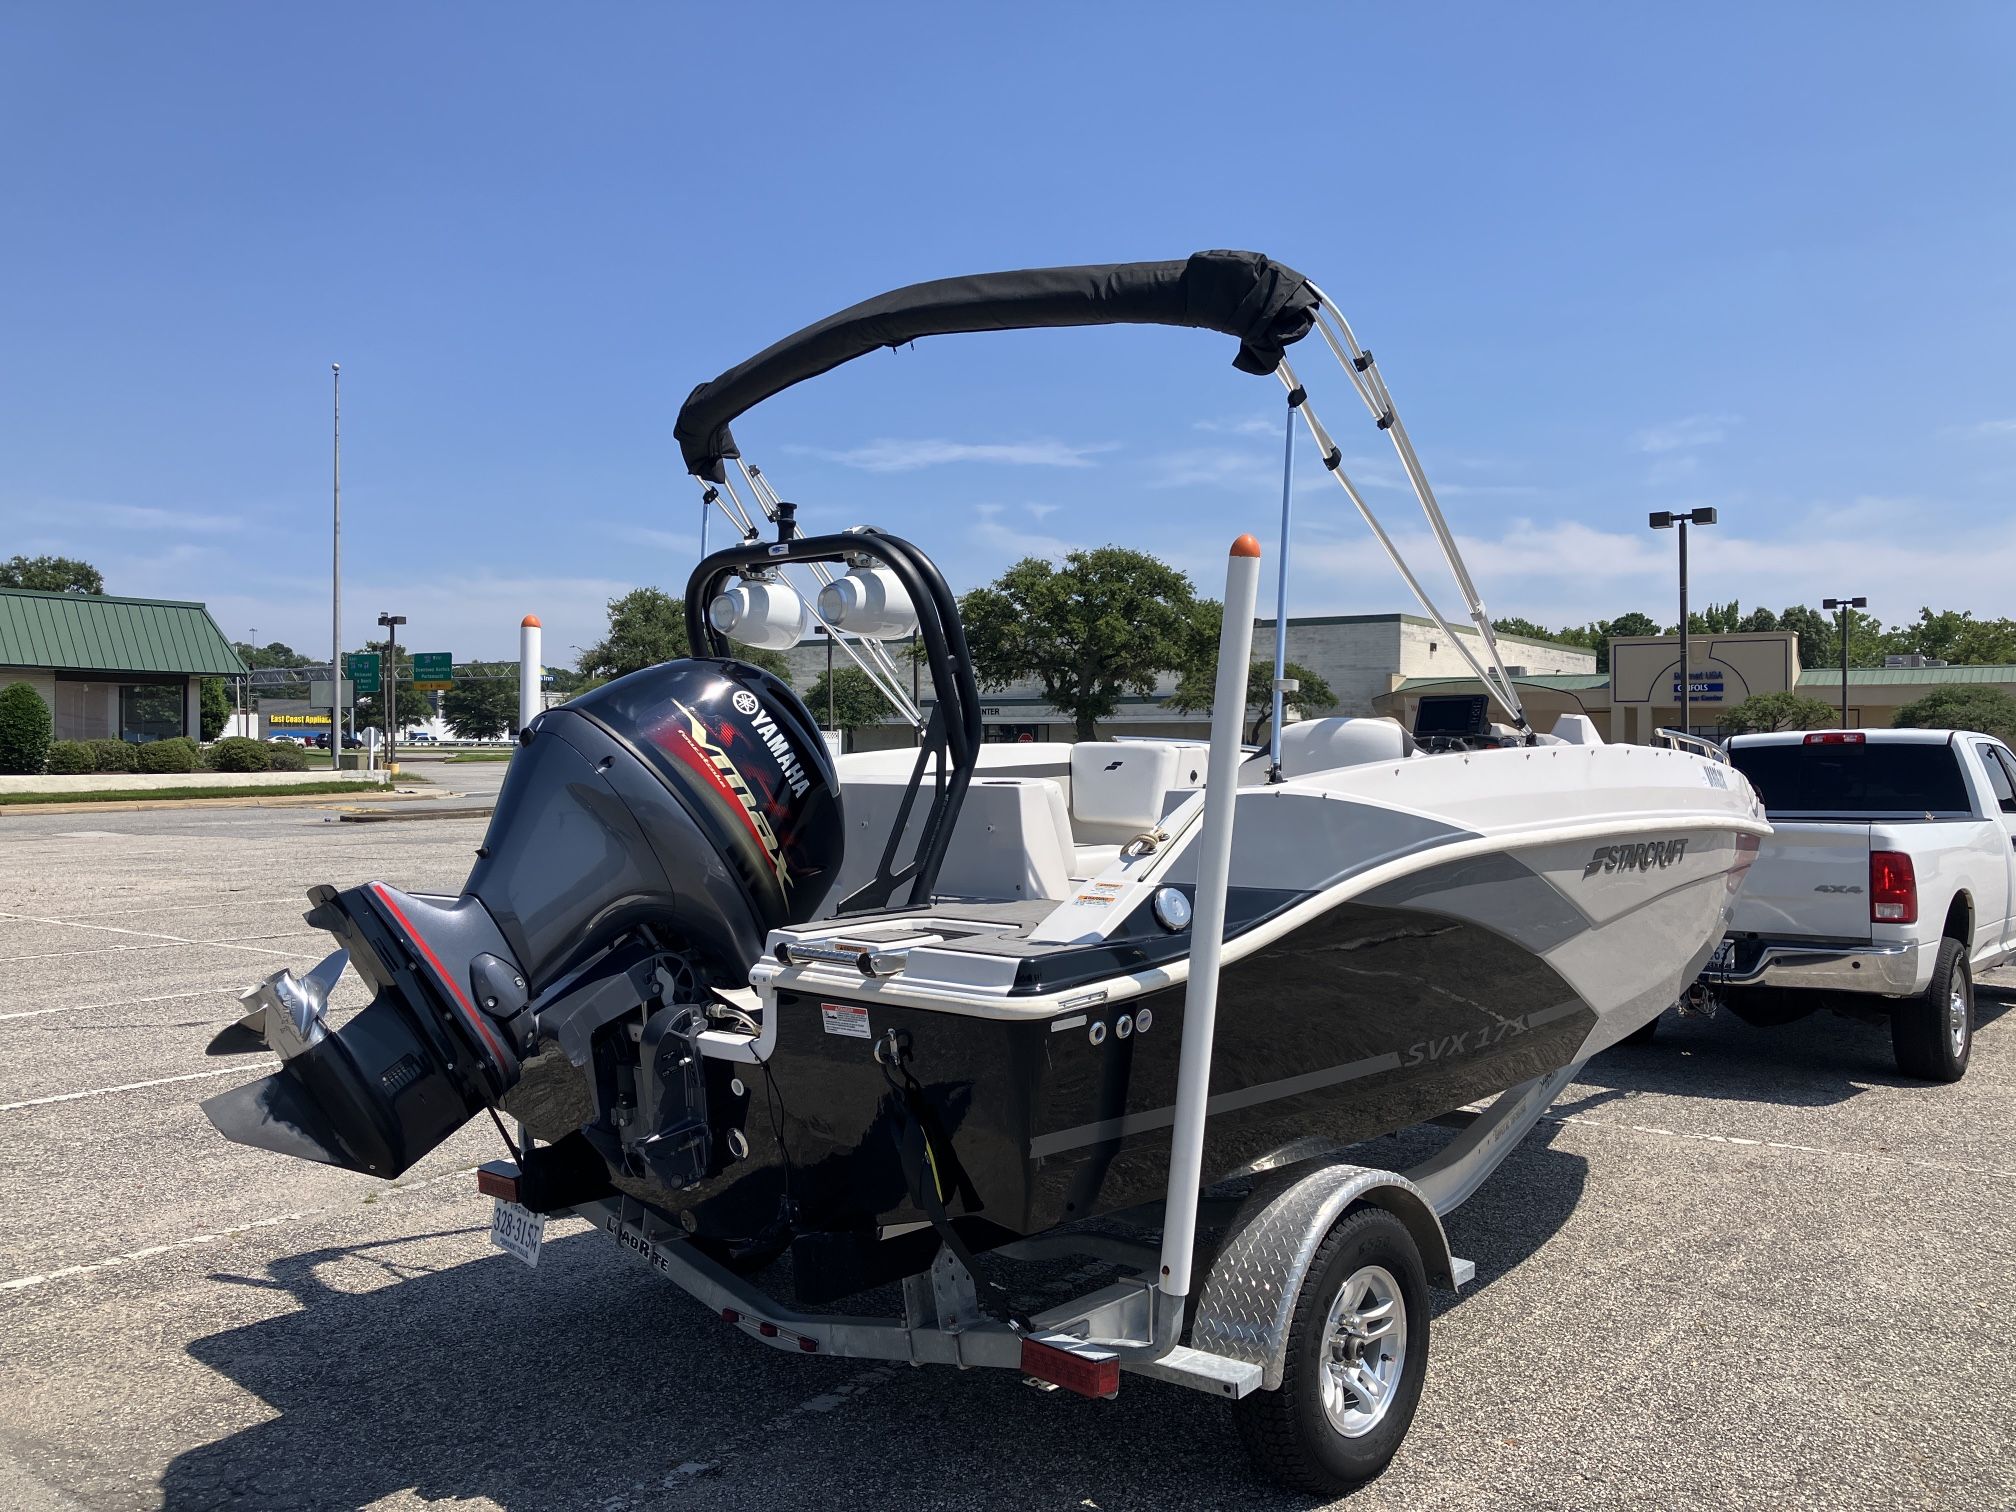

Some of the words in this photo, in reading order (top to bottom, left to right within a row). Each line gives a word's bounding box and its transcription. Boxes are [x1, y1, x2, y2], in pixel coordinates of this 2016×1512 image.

[270, 714, 285, 723] East
[285, 715, 305, 724] Coast
[981, 708, 1000, 716] NTER
[750, 708, 811, 800] YAMAHA
[1605, 838, 1689, 872] STARCRAFT
[1404, 1031, 1469, 1067] SVX
[606, 1214, 670, 1274] LADRTE
